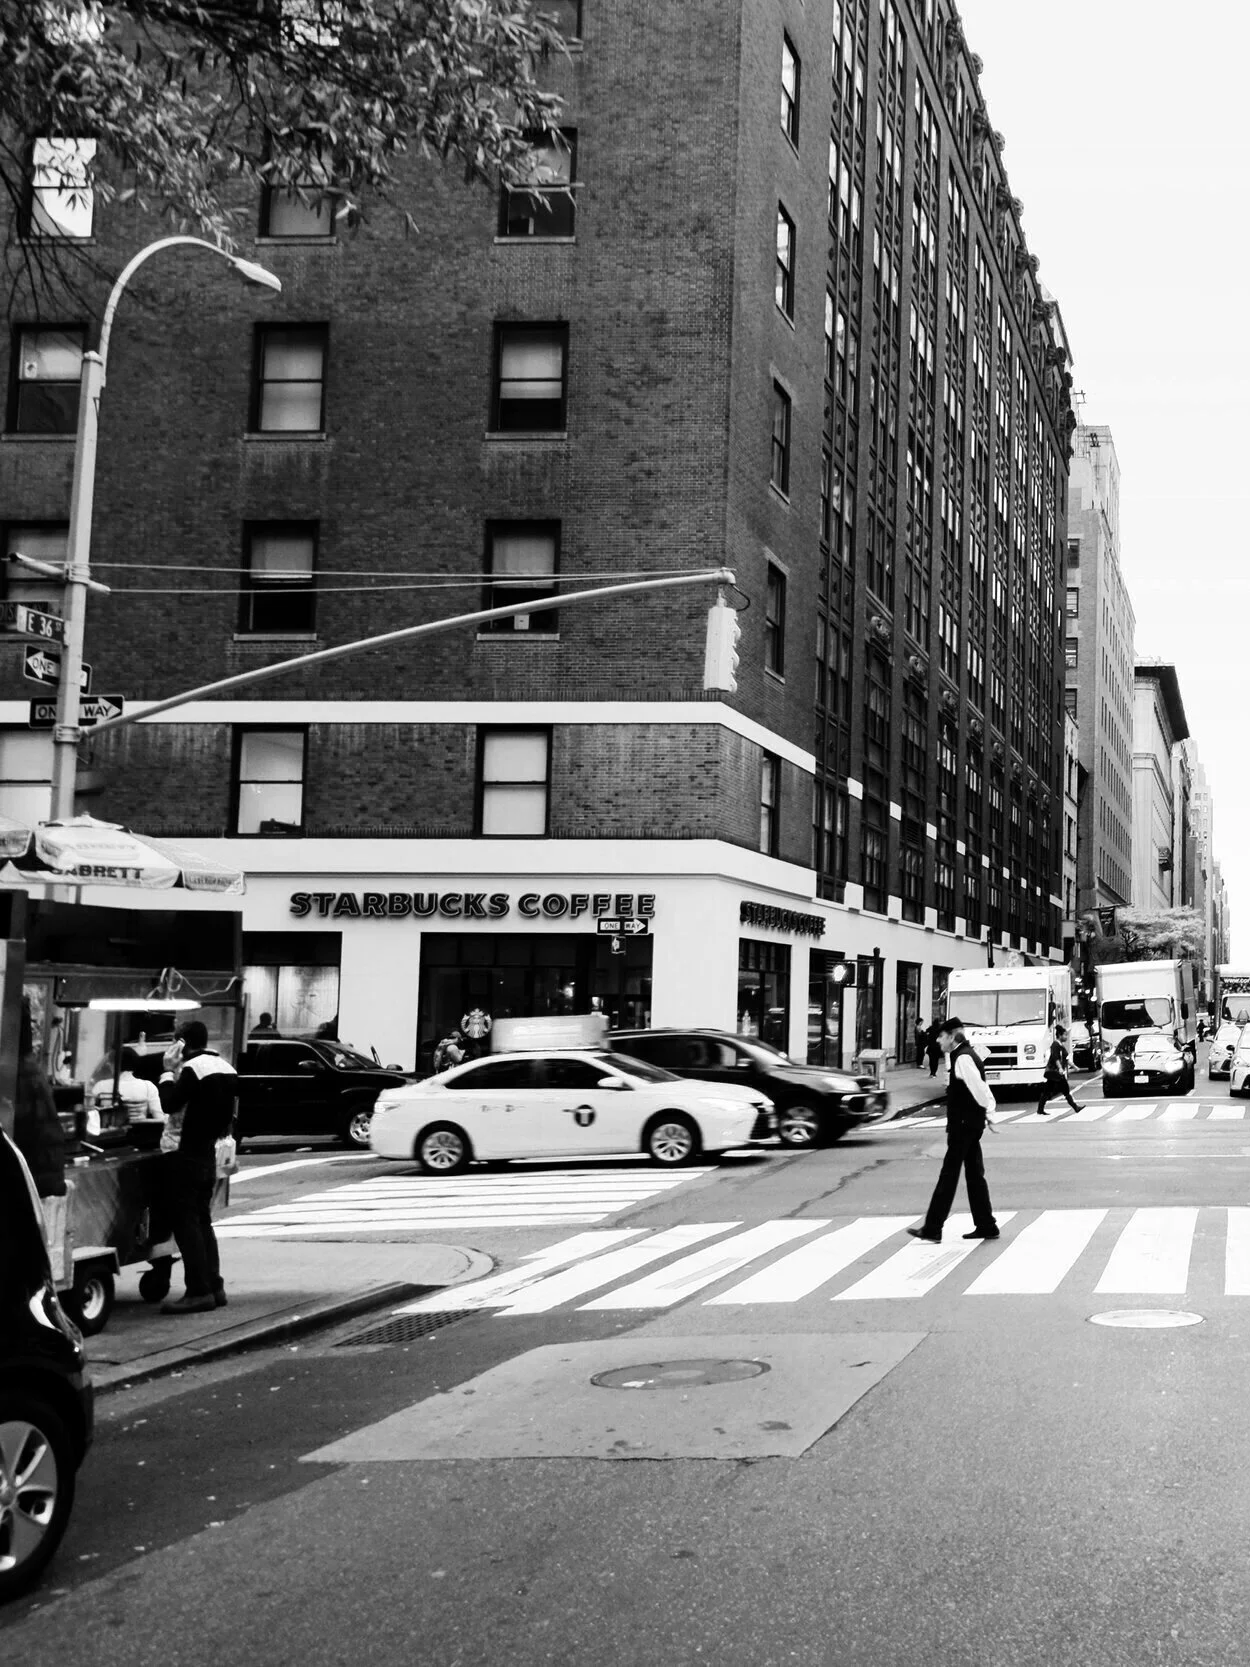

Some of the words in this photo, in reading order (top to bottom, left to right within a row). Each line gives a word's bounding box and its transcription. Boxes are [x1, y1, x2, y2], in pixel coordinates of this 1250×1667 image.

[28, 613, 35, 632] E
[40, 616, 53, 637] 36
[31, 657, 55, 675] ONE
[38, 706, 57, 718] ON
[84, 704, 112, 718] WAY
[290, 892, 509, 917] STARBUCKS
[518, 893, 656, 917] COFFEE
[604, 922, 619, 930] ONE
[625, 922, 641, 930] WAY
